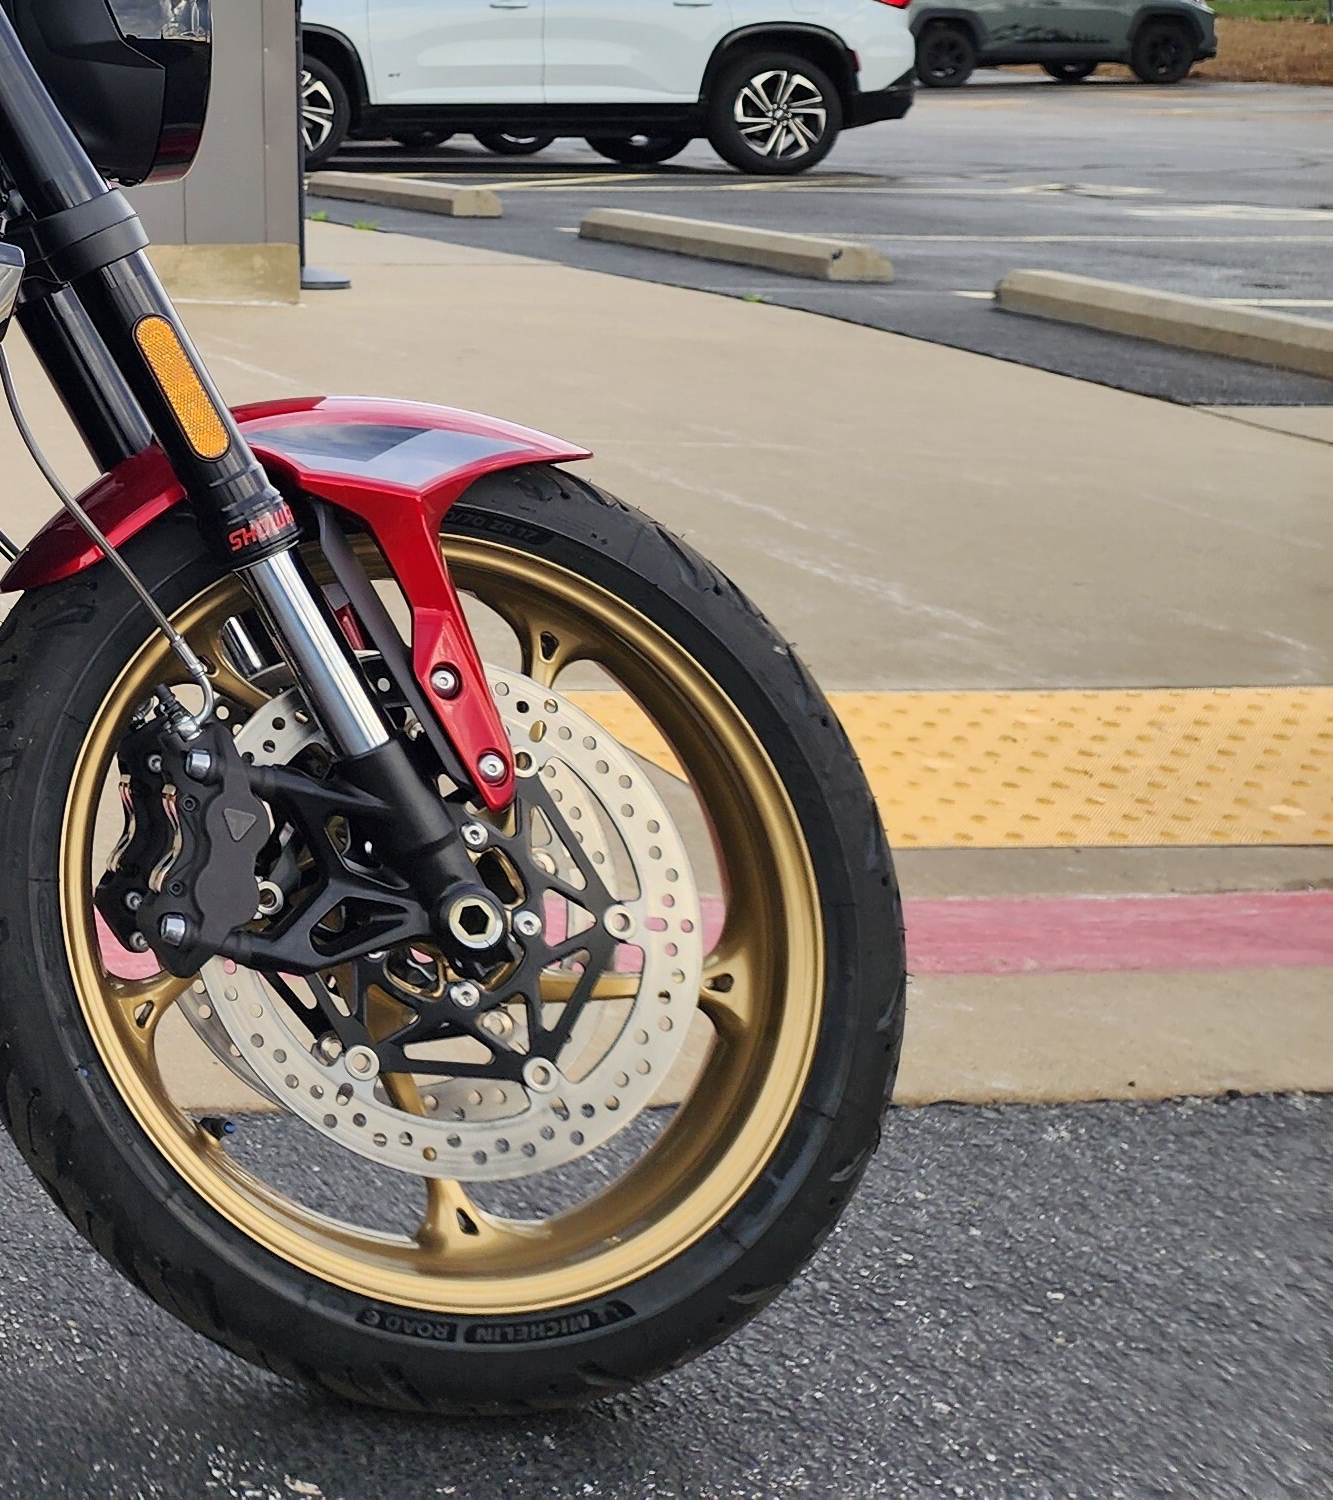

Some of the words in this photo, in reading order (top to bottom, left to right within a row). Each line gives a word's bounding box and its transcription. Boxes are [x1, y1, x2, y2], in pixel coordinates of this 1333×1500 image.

[228, 503, 295, 552] SHOWA
[386, 1309, 449, 1339] ROAD
[475, 1313, 591, 1342] MICHELIN
